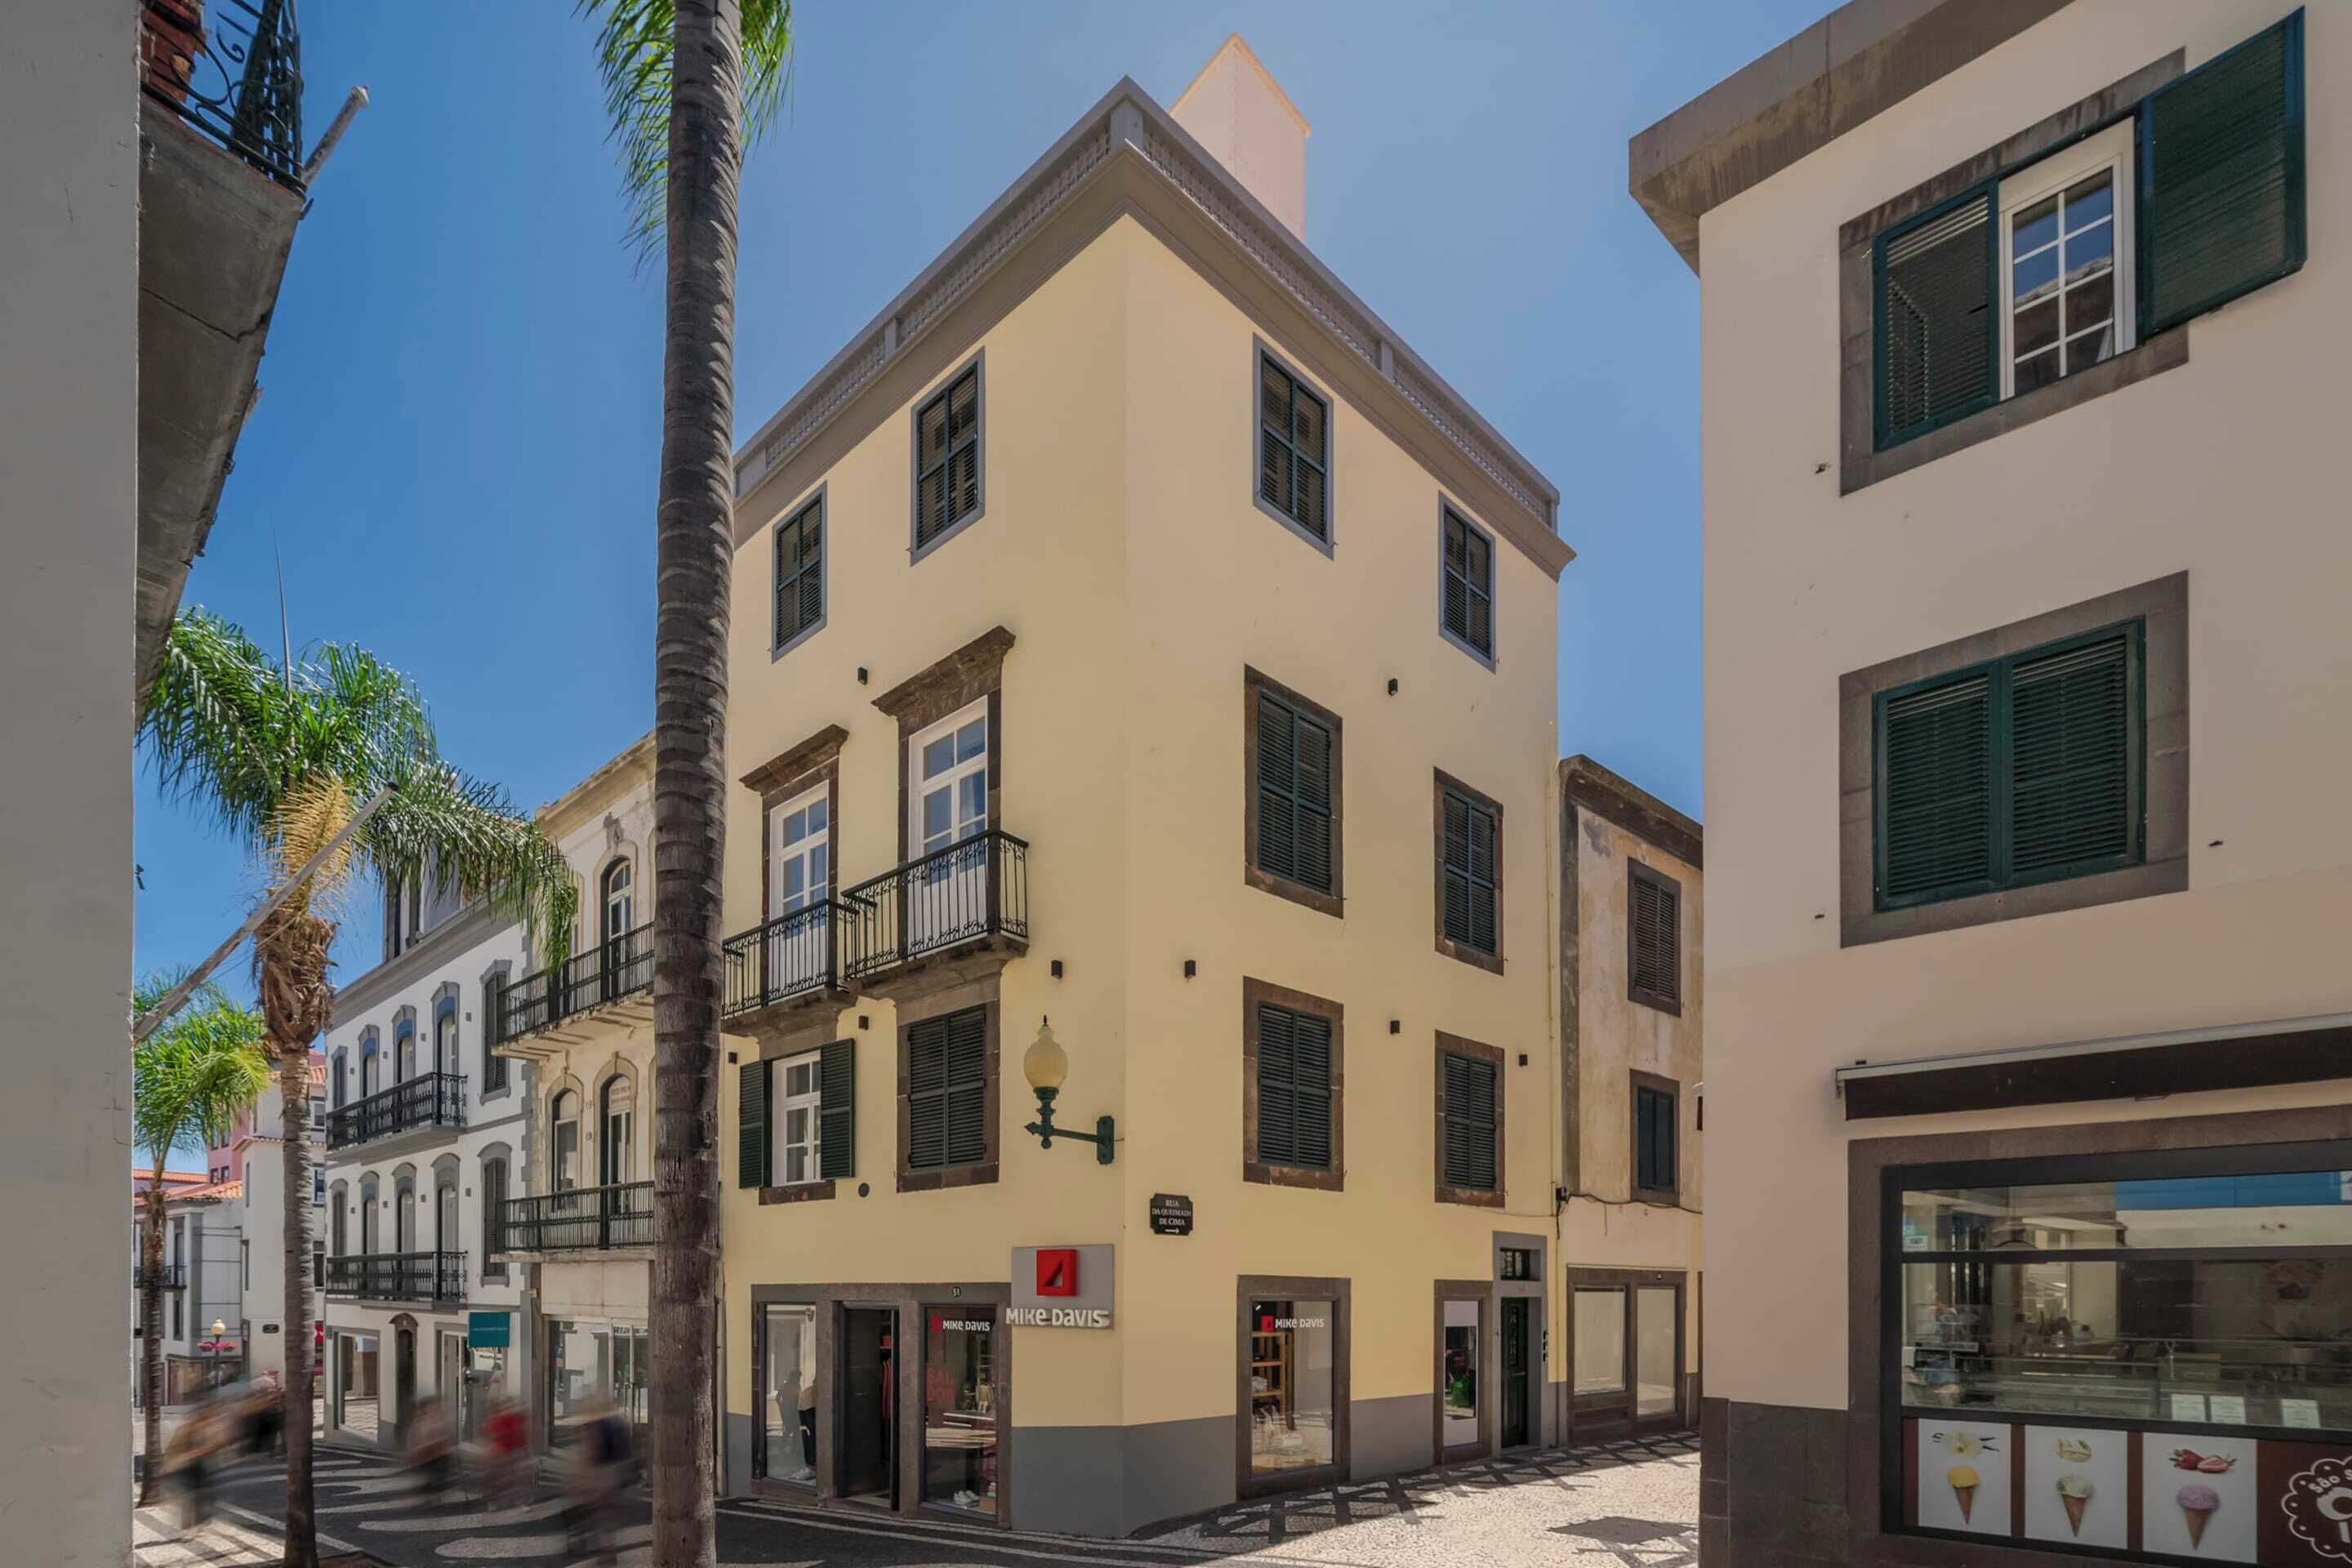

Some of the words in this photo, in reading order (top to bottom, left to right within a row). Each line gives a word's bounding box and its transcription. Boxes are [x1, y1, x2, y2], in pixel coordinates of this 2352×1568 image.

[1165, 1199, 1179, 1207] RUA
[1169, 1218, 1185, 1226] CIMA
[1005, 1307, 1046, 1325] MIKe
[1051, 1308, 1111, 1328] DaVIS
[942, 1319, 964, 1331] MIKe
[964, 1321, 991, 1332] DaVIS
[1275, 1318, 1298, 1329] MIKe
[1299, 1318, 1325, 1328] DaVIS
